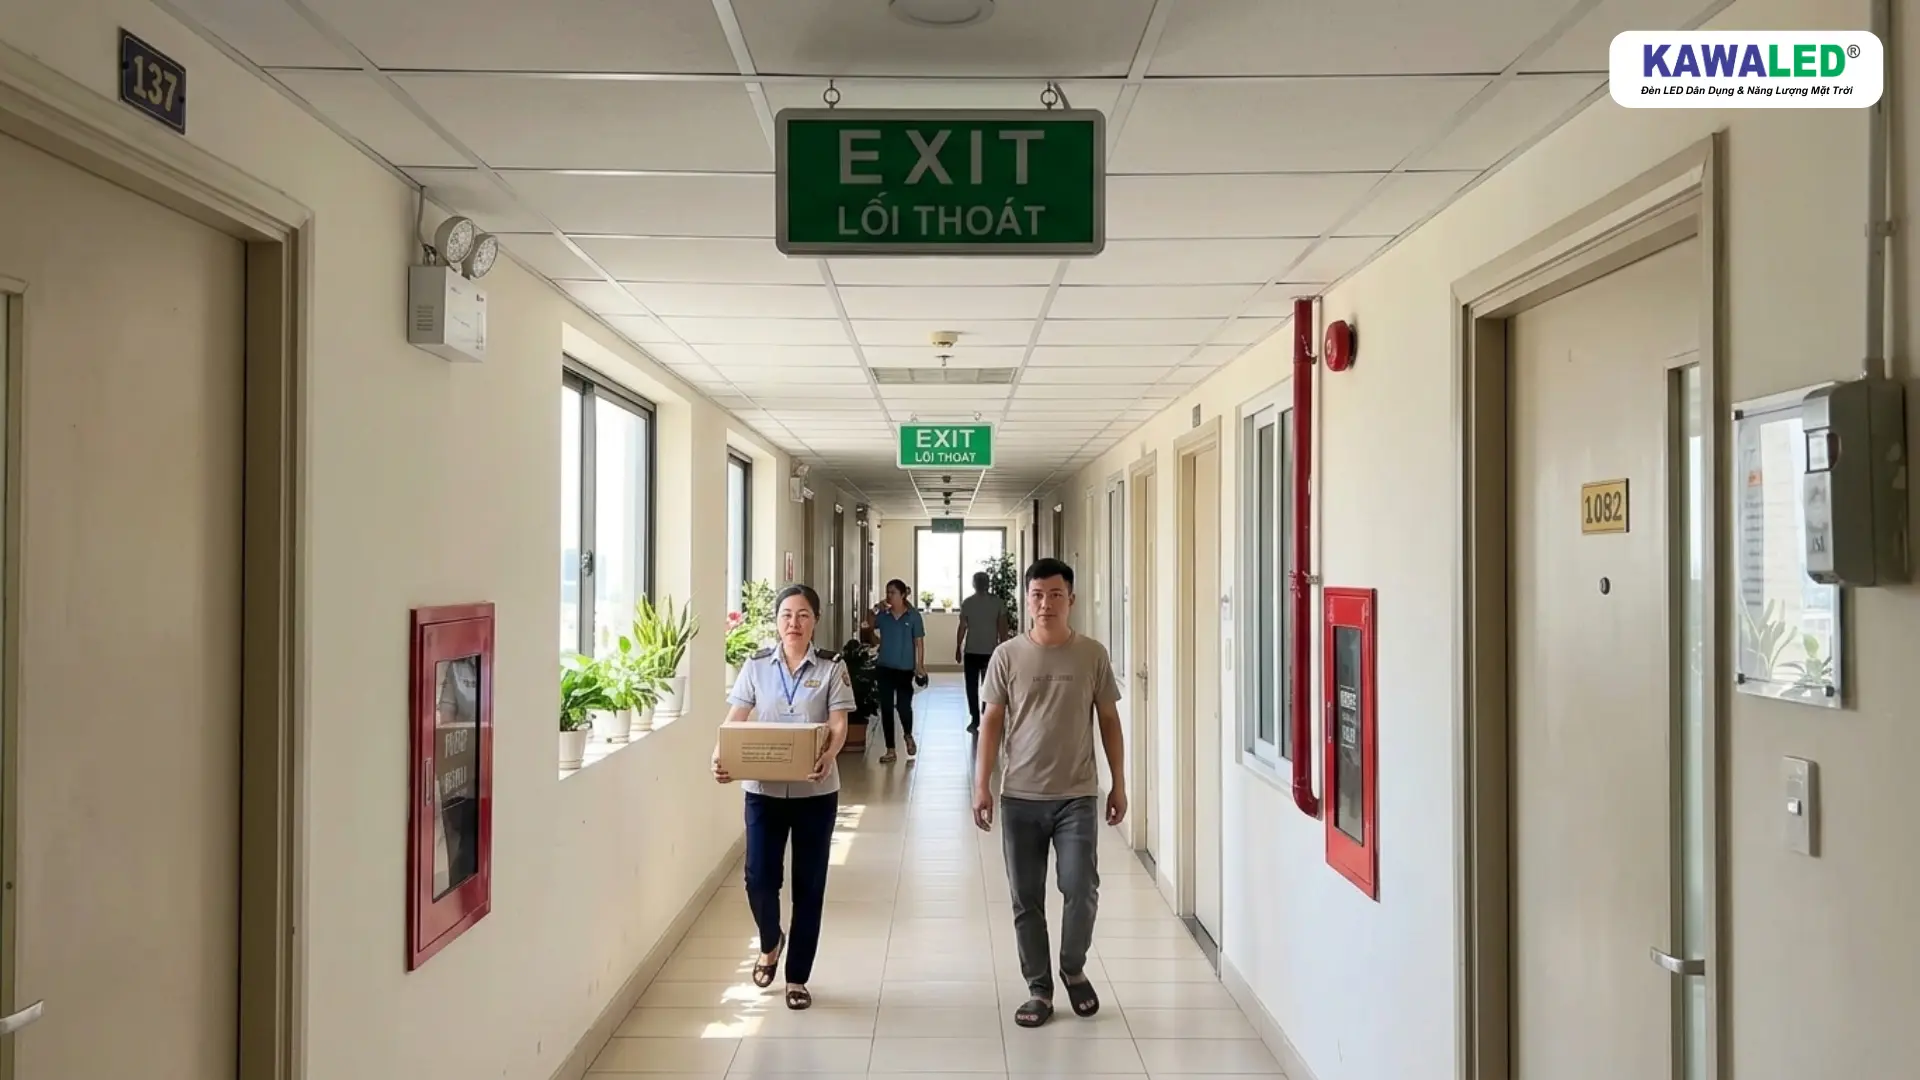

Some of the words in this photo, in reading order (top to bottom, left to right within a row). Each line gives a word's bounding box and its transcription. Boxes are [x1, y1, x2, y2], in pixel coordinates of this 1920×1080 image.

[133, 55, 177, 112] 137
[838, 129, 1046, 185] EXIT
[837, 191, 899, 236] LỐI
[913, 197, 1046, 236] THOÁT
[916, 429, 976, 448] EXIT
[1584, 491, 1622, 524] 1082
